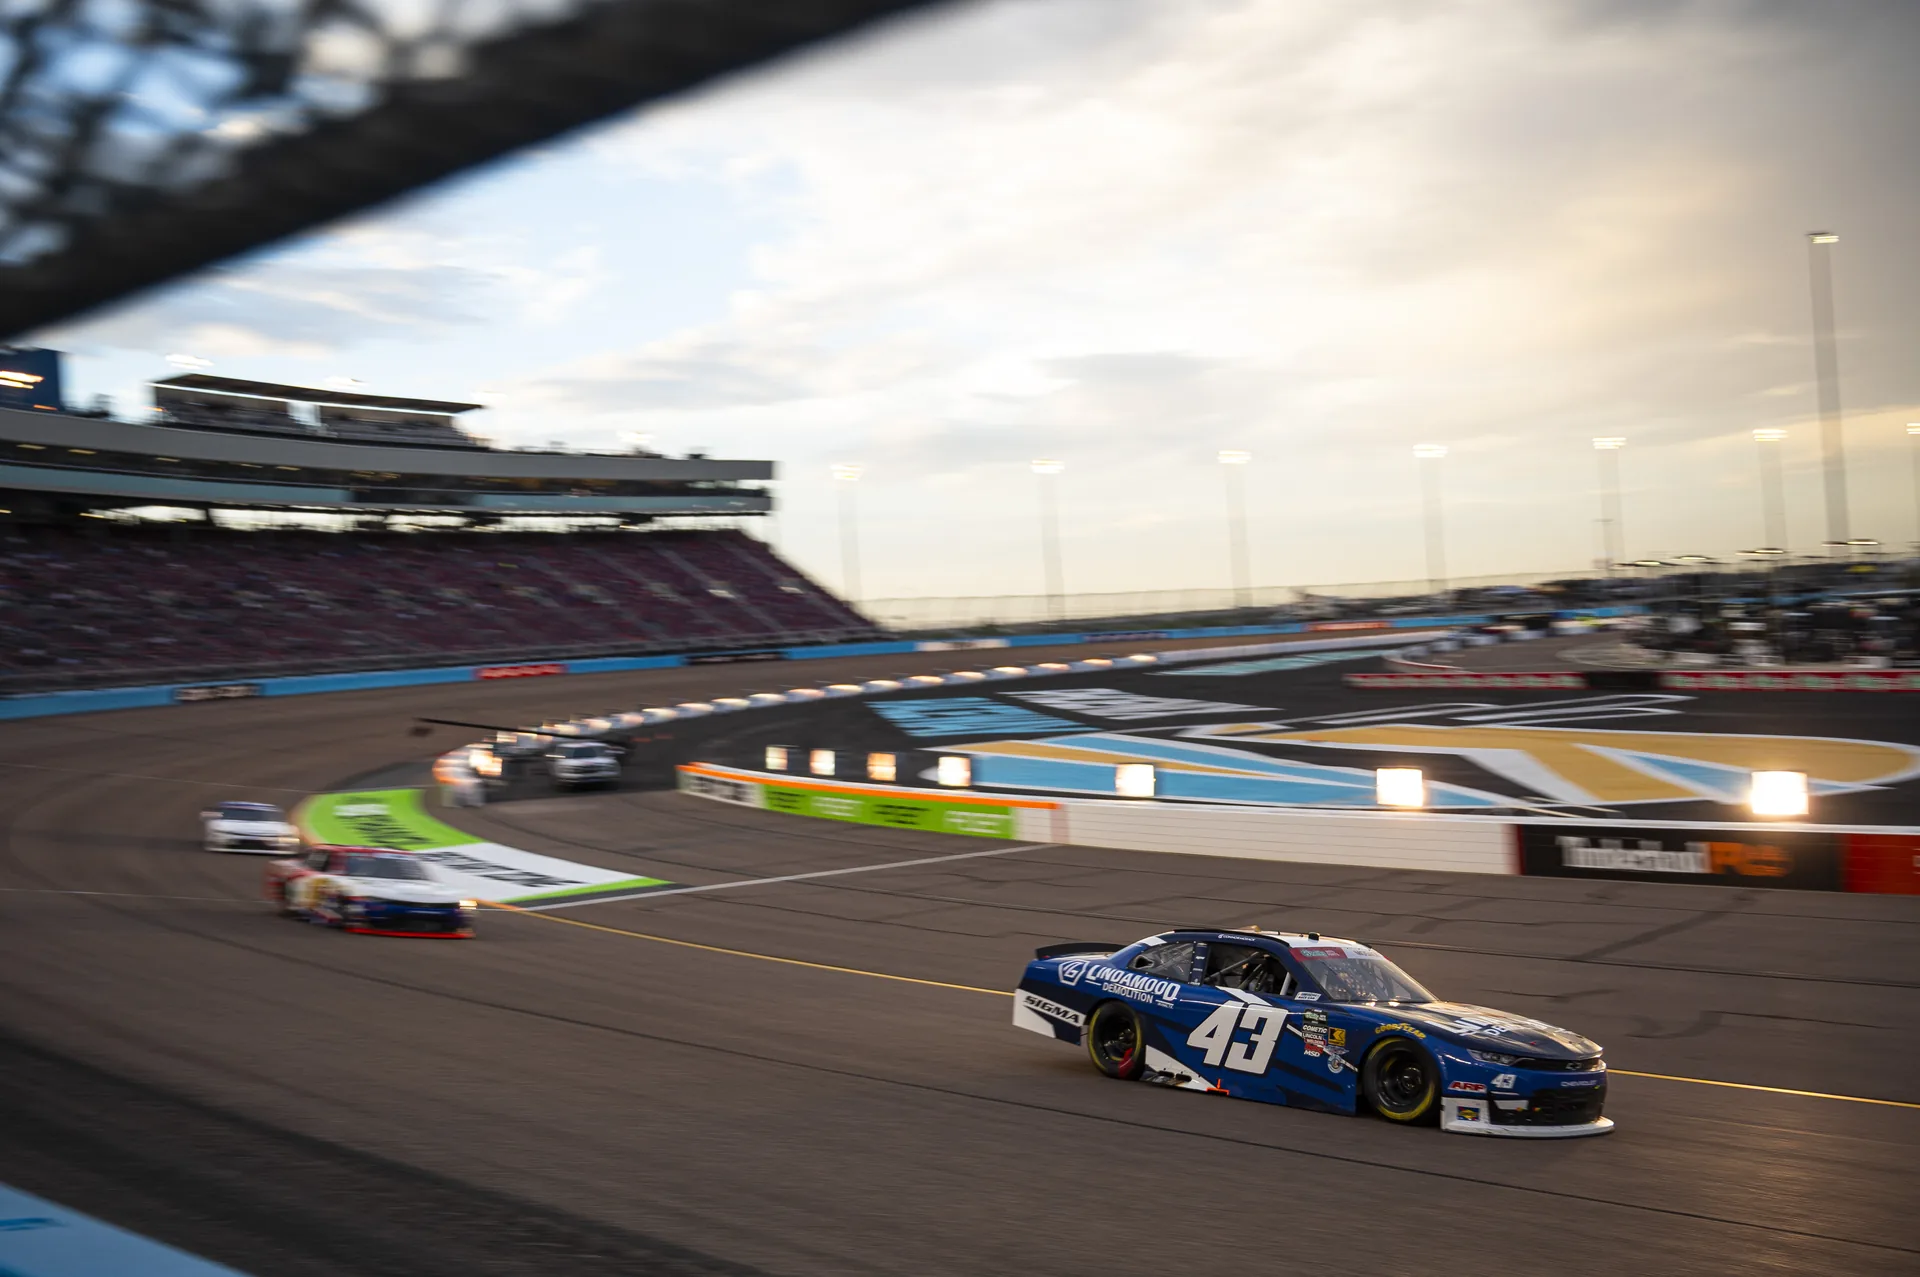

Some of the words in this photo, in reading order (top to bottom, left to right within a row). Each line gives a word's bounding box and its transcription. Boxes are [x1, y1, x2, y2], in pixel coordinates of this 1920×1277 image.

[1085, 964, 1181, 1001] LINDAMOOD
[1102, 982, 1154, 1004] DEMOLITION
[1024, 995, 1080, 1023] SIGMA
[1187, 1000, 1288, 1075] 43
[1302, 1024, 1328, 1034] COMETIC
[1375, 1022, 1427, 1040] GOODYEAR
[1303, 1049, 1321, 1058] MSD
[1451, 1081, 1486, 1092] ARP
[1490, 1073, 1517, 1089] 43
